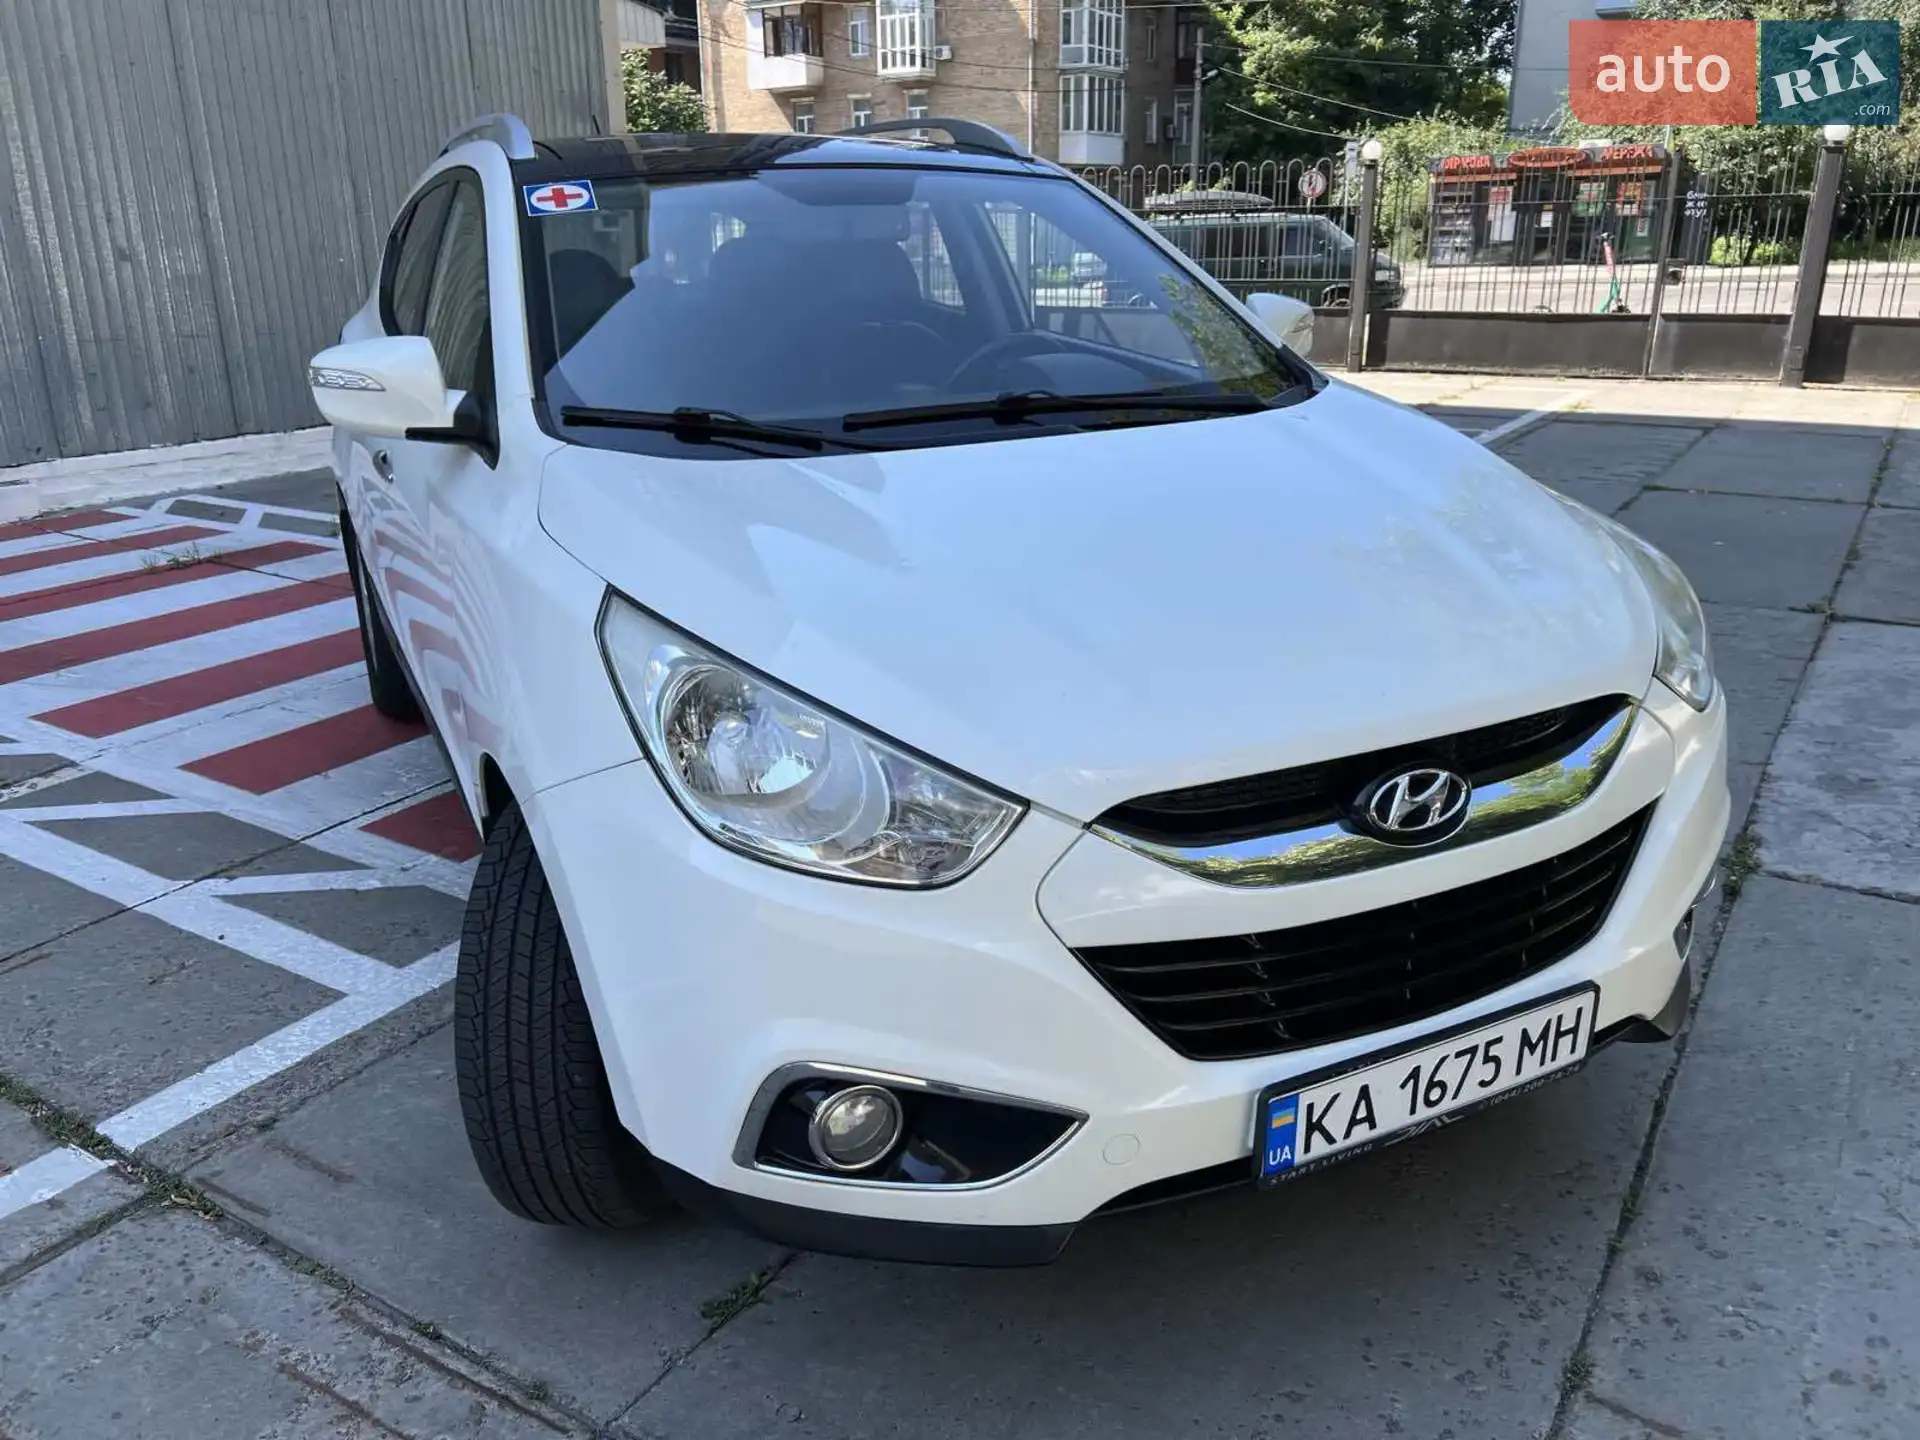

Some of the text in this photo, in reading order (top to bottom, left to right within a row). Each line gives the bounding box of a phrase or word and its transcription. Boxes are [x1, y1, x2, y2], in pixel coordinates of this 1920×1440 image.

[1303, 1006, 1584, 1154] KA 1675 MH
[1269, 1145, 1292, 1165] UA
